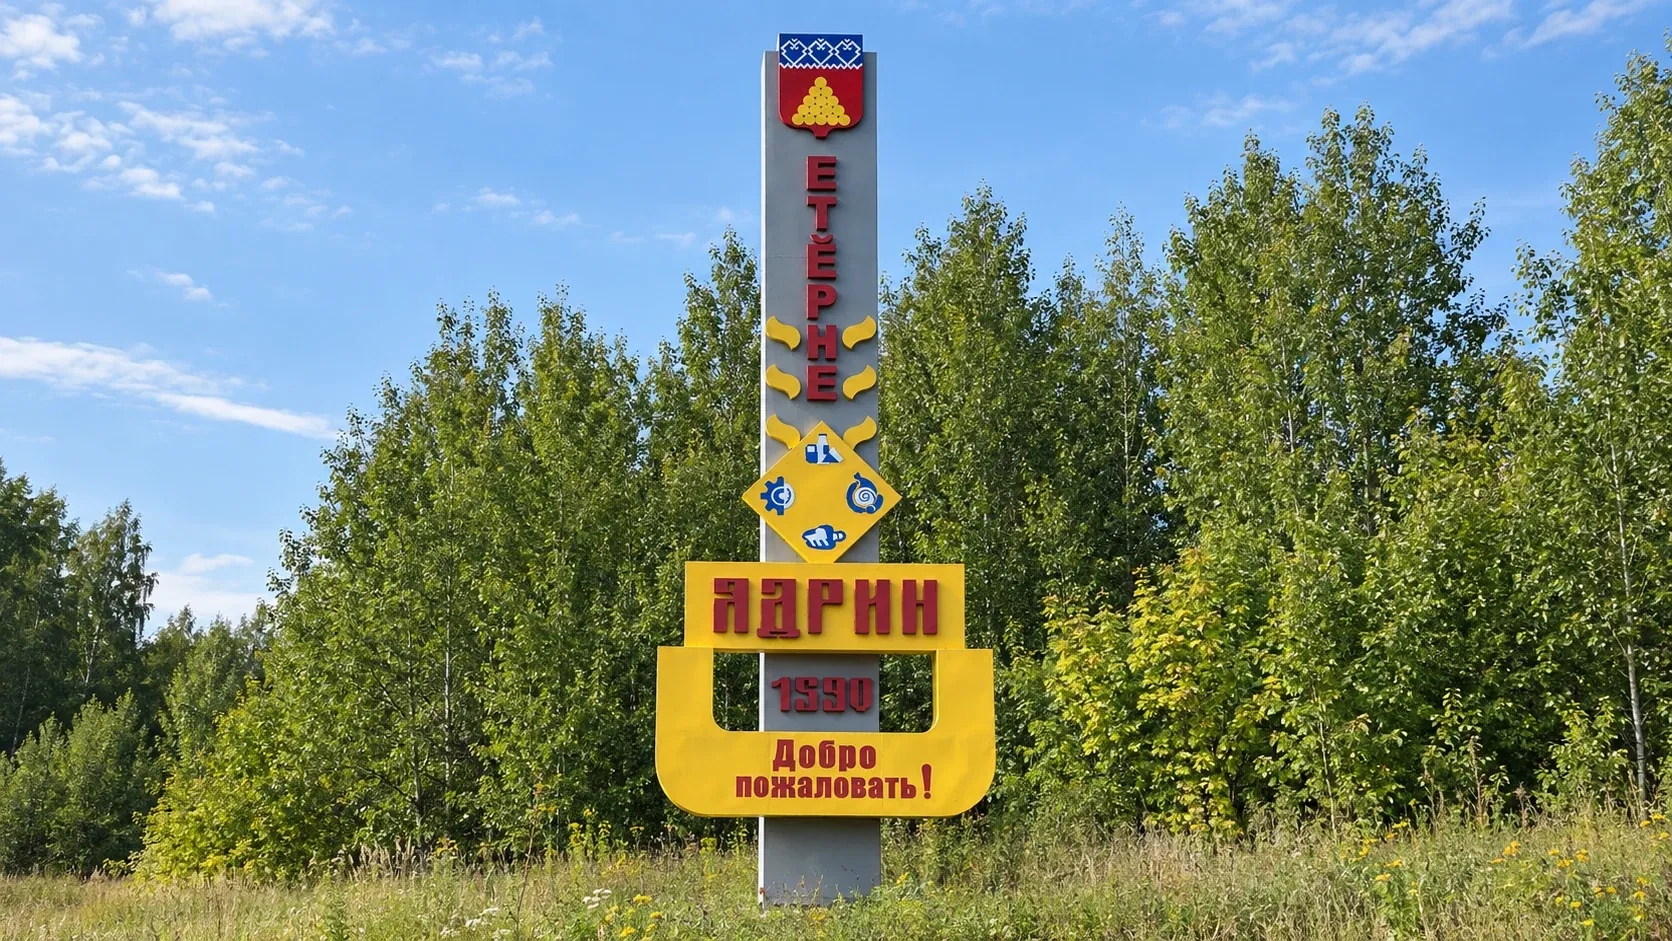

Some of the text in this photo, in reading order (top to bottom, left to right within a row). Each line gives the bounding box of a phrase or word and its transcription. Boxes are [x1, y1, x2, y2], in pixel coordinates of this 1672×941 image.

[712, 577, 939, 639] ЯДРИН
[771, 676, 874, 713] 1590
[772, 739, 877, 773] Добро
[735, 763, 933, 800] пожаловать!
